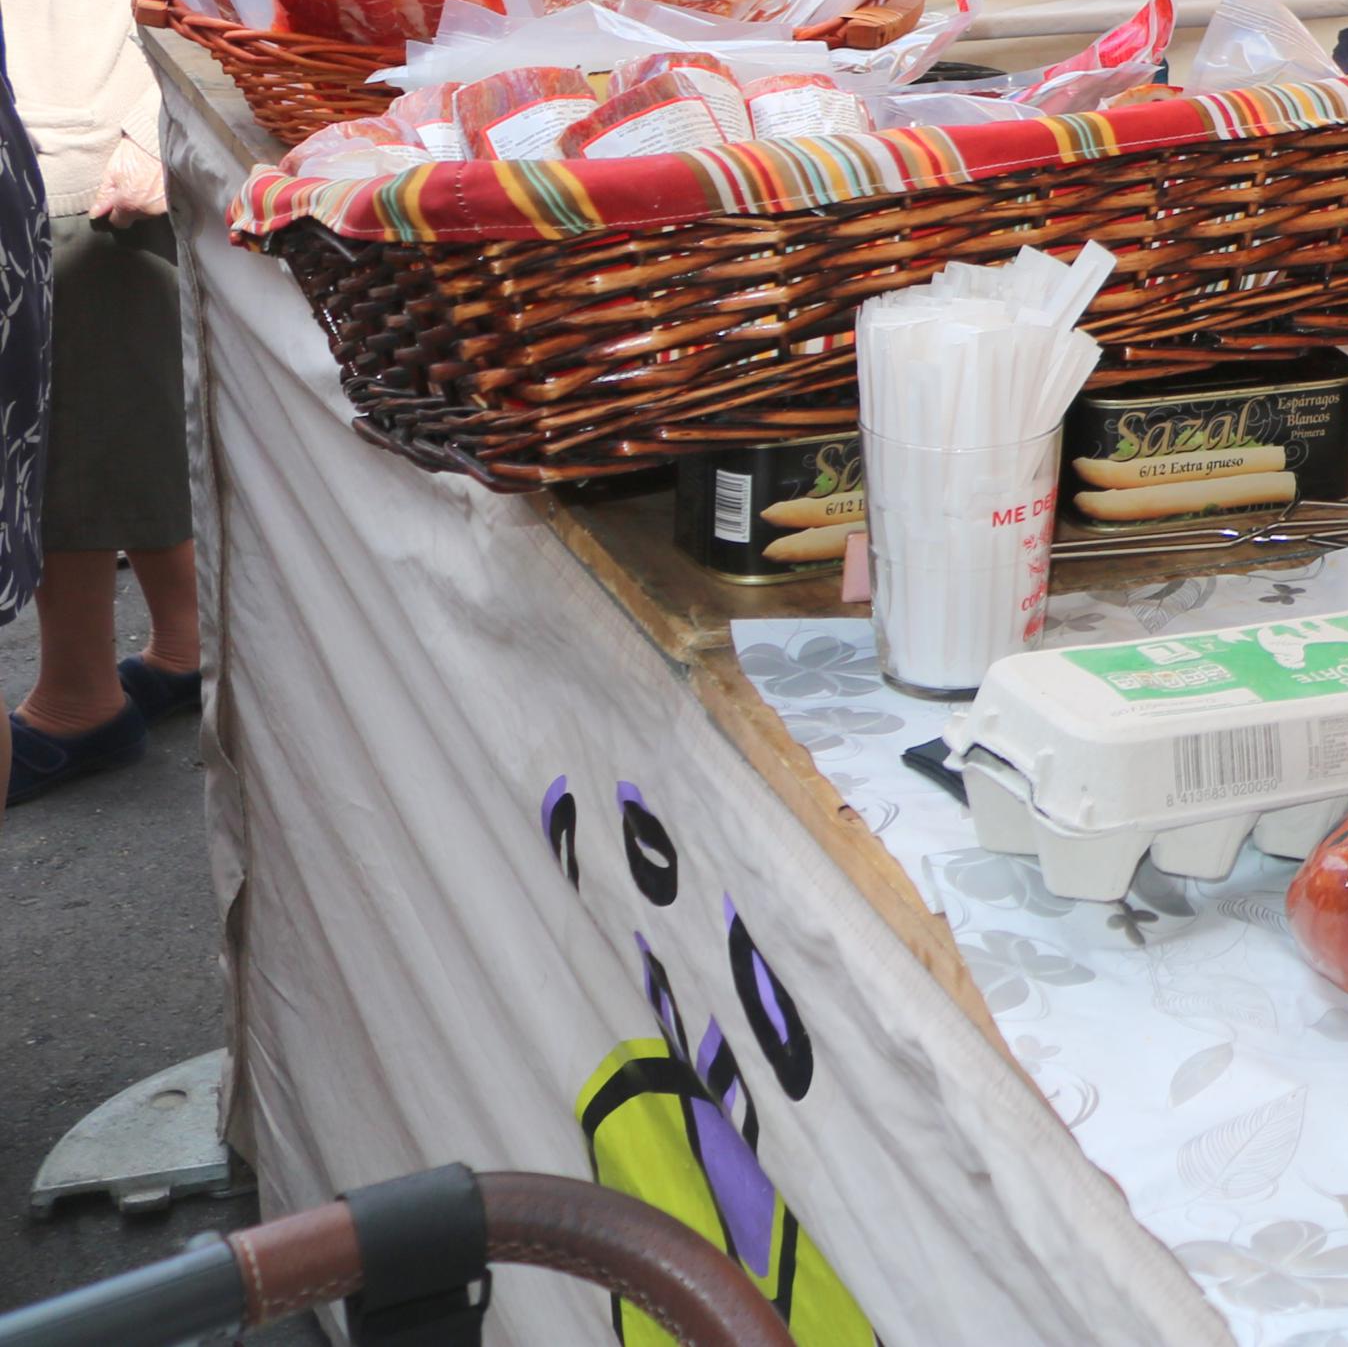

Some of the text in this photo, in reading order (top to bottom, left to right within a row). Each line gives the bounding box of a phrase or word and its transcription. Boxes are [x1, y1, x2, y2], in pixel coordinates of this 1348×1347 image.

[1277, 392, 1341, 414] Espárragos
[1110, 395, 1266, 463] Sazal
[1286, 410, 1331, 426] Blancos
[1290, 429, 1326, 439] Primera
[1139, 456, 1243, 478] 6/12 Extra grueso
[825, 500, 853, 516] 6/12
[992, 505, 1027, 528] ME
